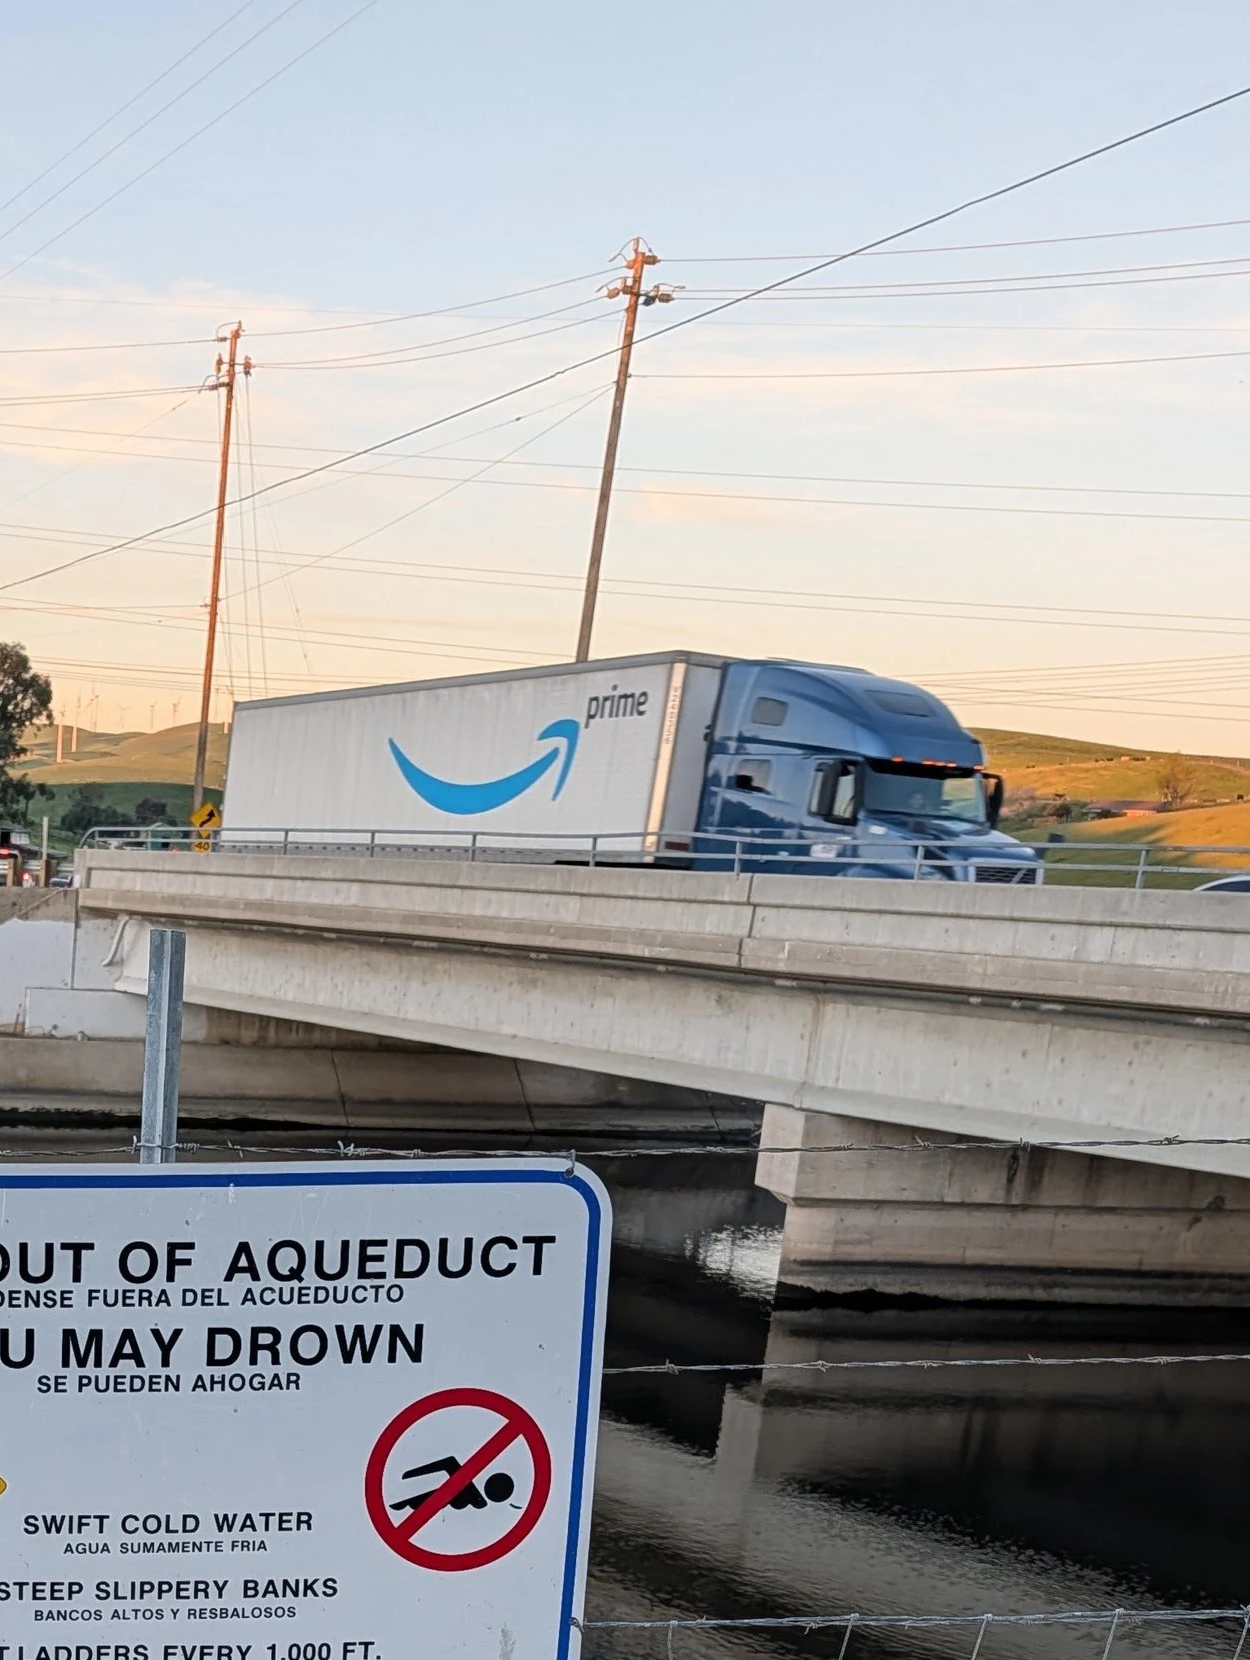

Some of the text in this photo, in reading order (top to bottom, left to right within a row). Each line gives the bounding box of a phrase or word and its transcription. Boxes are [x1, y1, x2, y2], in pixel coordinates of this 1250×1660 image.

[584, 683, 649, 729] prime
[118, 1240, 196, 1285] OF
[222, 1235, 557, 1284] AQUEDUCT
[87, 1288, 172, 1308] FUERA
[181, 1287, 230, 1307] DEL
[240, 1283, 404, 1306] ACUEDUCTO
[61, 1328, 184, 1369] MAY
[205, 1323, 424, 1367] DROWN
[36, 1372, 301, 1394] SE PUEDEN AHOGAR
[23, 1511, 313, 1535] SWIFT COLD WATER
[63, 1539, 268, 1555] AGUA SUMAMENTE FRIA
[94, 1579, 229, 1601] SLIPPERY
[242, 1577, 338, 1599] BANKS
[34, 1606, 297, 1622] BANCOS ALTOS Y RESBALOSOS
[342, 1641, 381, 1660] FT.
